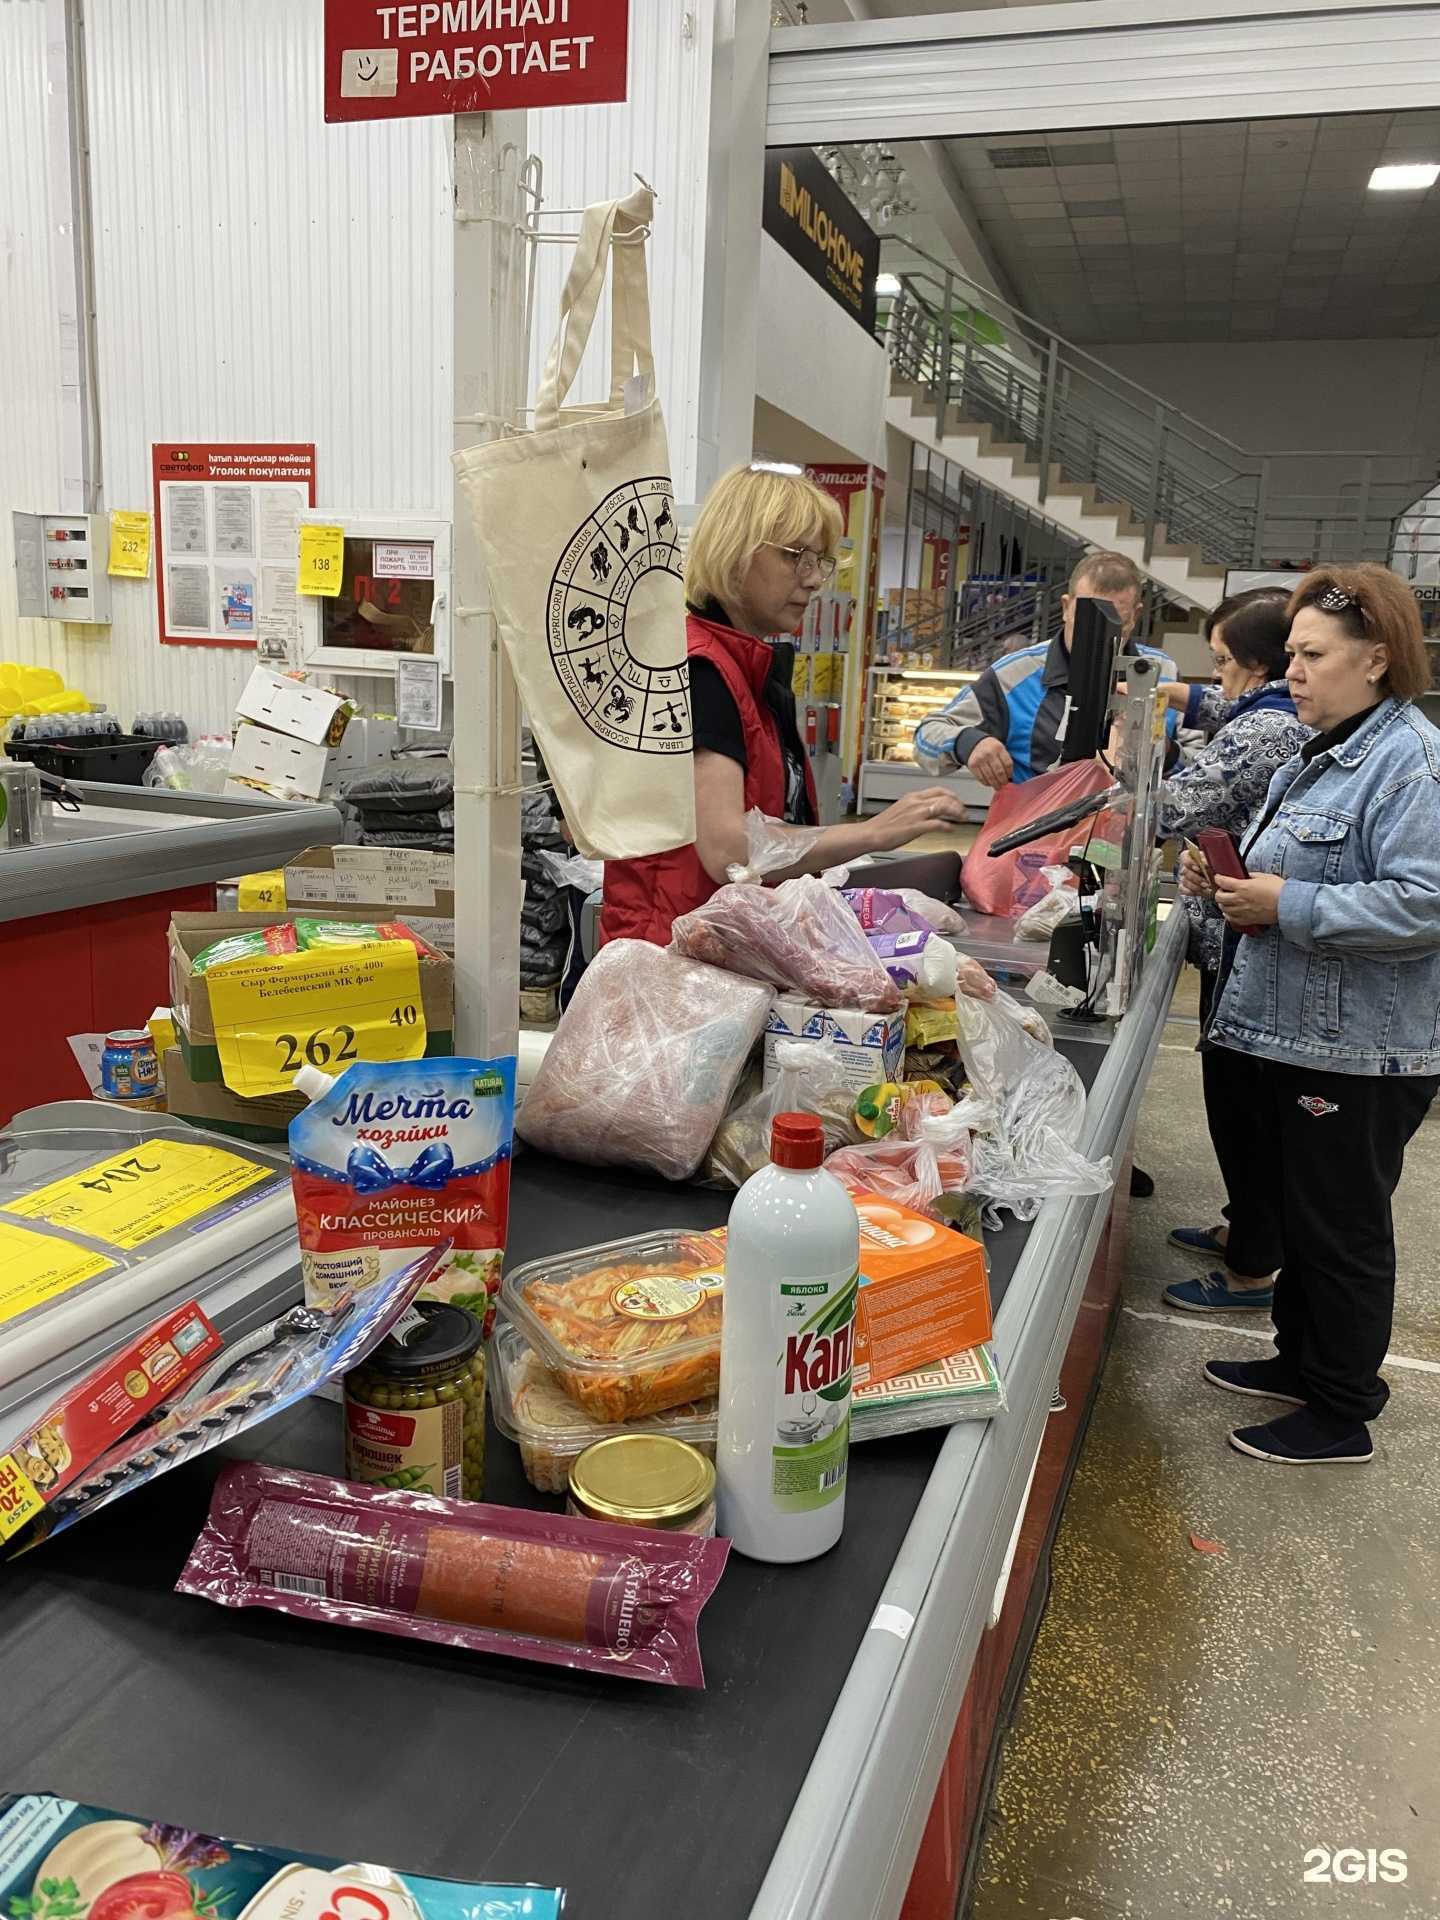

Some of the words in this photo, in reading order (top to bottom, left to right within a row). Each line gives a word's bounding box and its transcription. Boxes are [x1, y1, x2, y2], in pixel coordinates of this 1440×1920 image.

[376, 0, 569, 40] ТЕРМИНАЛ
[409, 36, 595, 83] РАБОТАЕТ
[159, 463, 204, 473] светофор
[209, 466, 247, 477] Уголок
[249, 467, 311, 478] покупателя
[604, 492, 626, 514] PISCES
[122, 541, 138, 553] 232
[562, 528, 592, 578] AQUARIUS
[312, 558, 330, 571] 138
[553, 588, 563, 648] CAPRICORN
[558, 657, 589, 713] SAGITTARIUS
[594, 719, 630, 744] SCORPIO
[658, 740, 684, 750] LIBRA
[258, 889, 273, 903] 42
[229, 965, 284, 976] светофор
[241, 976, 265, 987] Сыр
[268, 970, 335, 985] Фермерский
[259, 980, 332, 998] Белебеевский
[333, 978, 353, 987] МК
[355, 974, 374, 987] фас
[390, 1004, 417, 1028] 40
[275, 1024, 358, 1073] 262
[332, 1089, 473, 1126] Мечта
[357, 1124, 449, 1149] хозяйки
[368, 1197, 436, 1211] МАЙОНЕЗ
[319, 1204, 483, 1230] КЛАССИЧЕСКИЙ
[363, 1228, 441, 1241] ПРОВАНСАЛЬ
[790, 1285, 825, 1295] ЯБЛОКО
[784, 1320, 856, 1395] Кап
